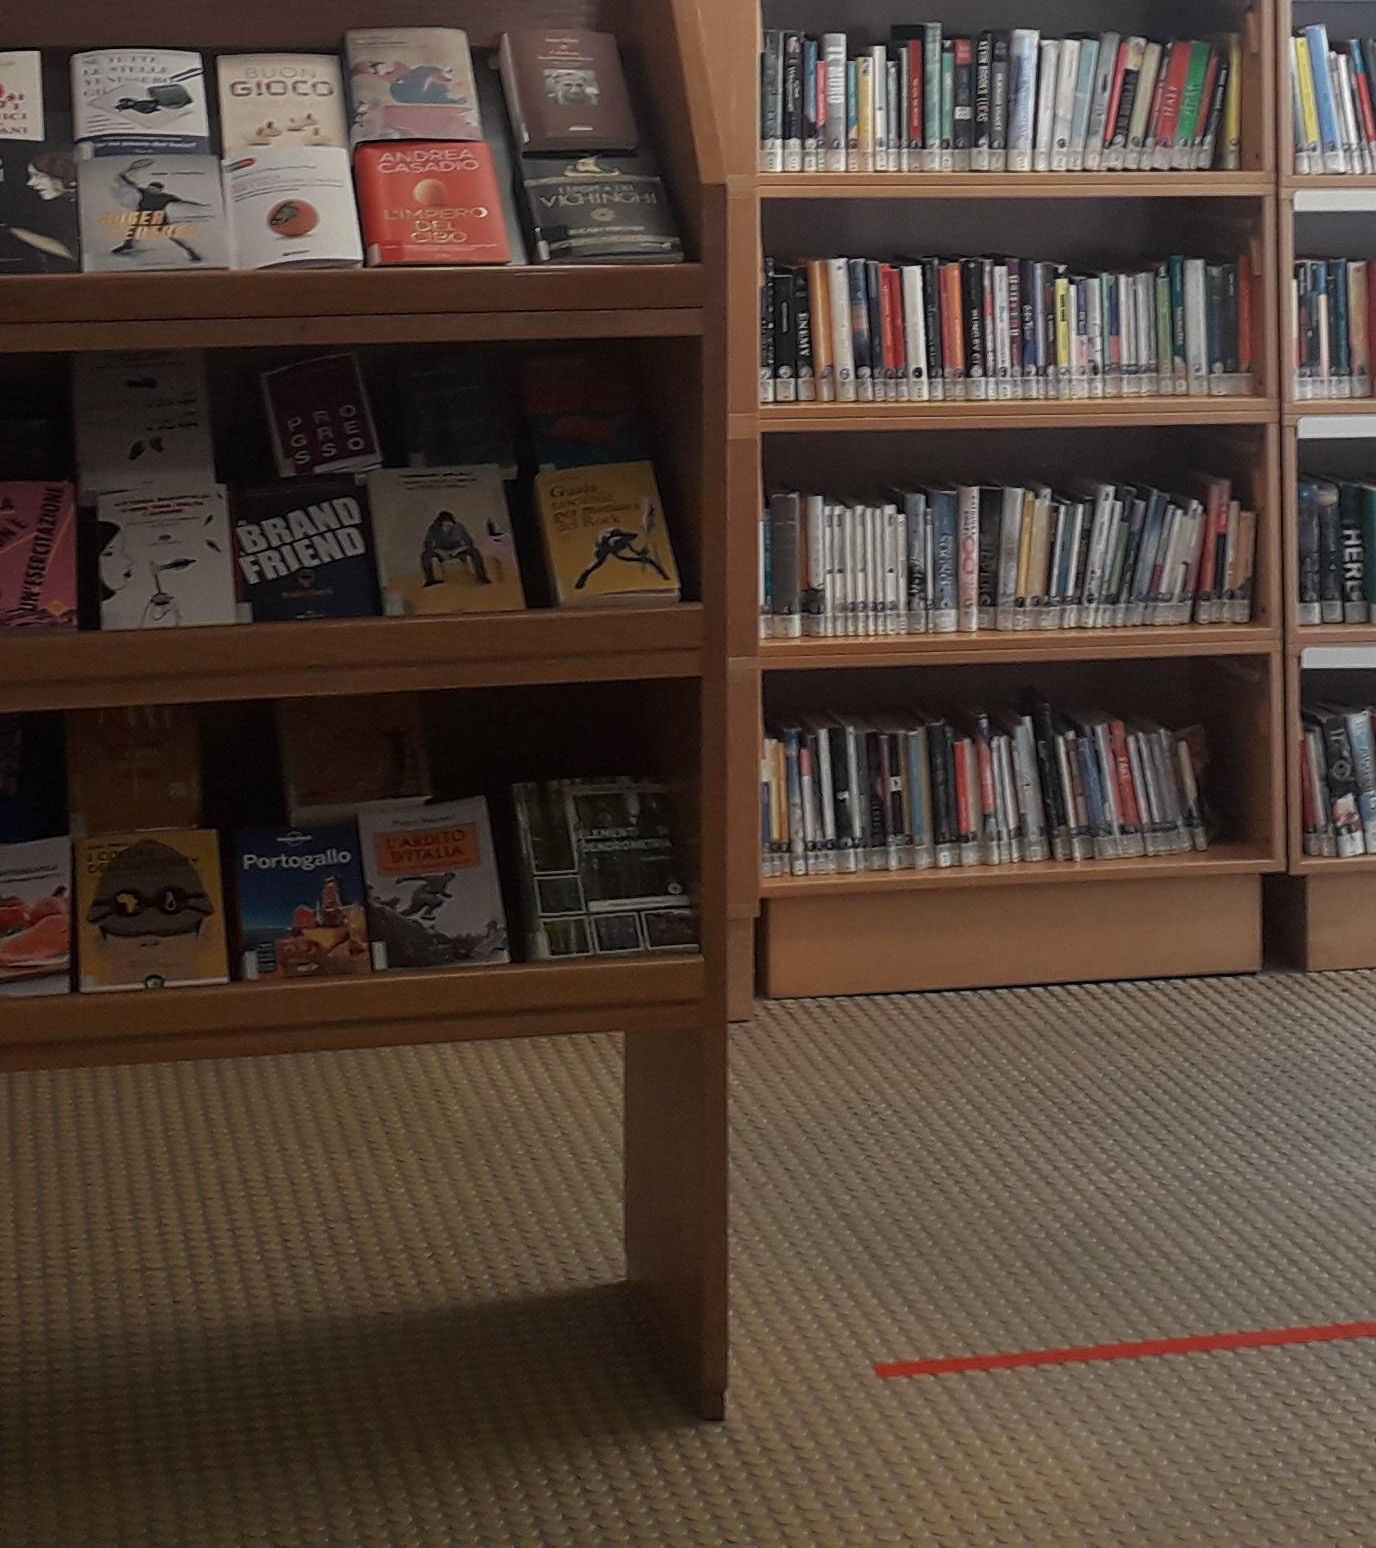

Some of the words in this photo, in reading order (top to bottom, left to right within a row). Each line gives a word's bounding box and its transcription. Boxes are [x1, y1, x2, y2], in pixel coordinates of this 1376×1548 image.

[244, 66, 317, 80] BUON
[379, 148, 475, 163] ANDREA
[377, 159, 480, 174] CASADIO
[236, 496, 363, 554] BRAND
[238, 526, 366, 585] FRIEND
[242, 848, 351, 871] Portogallo
